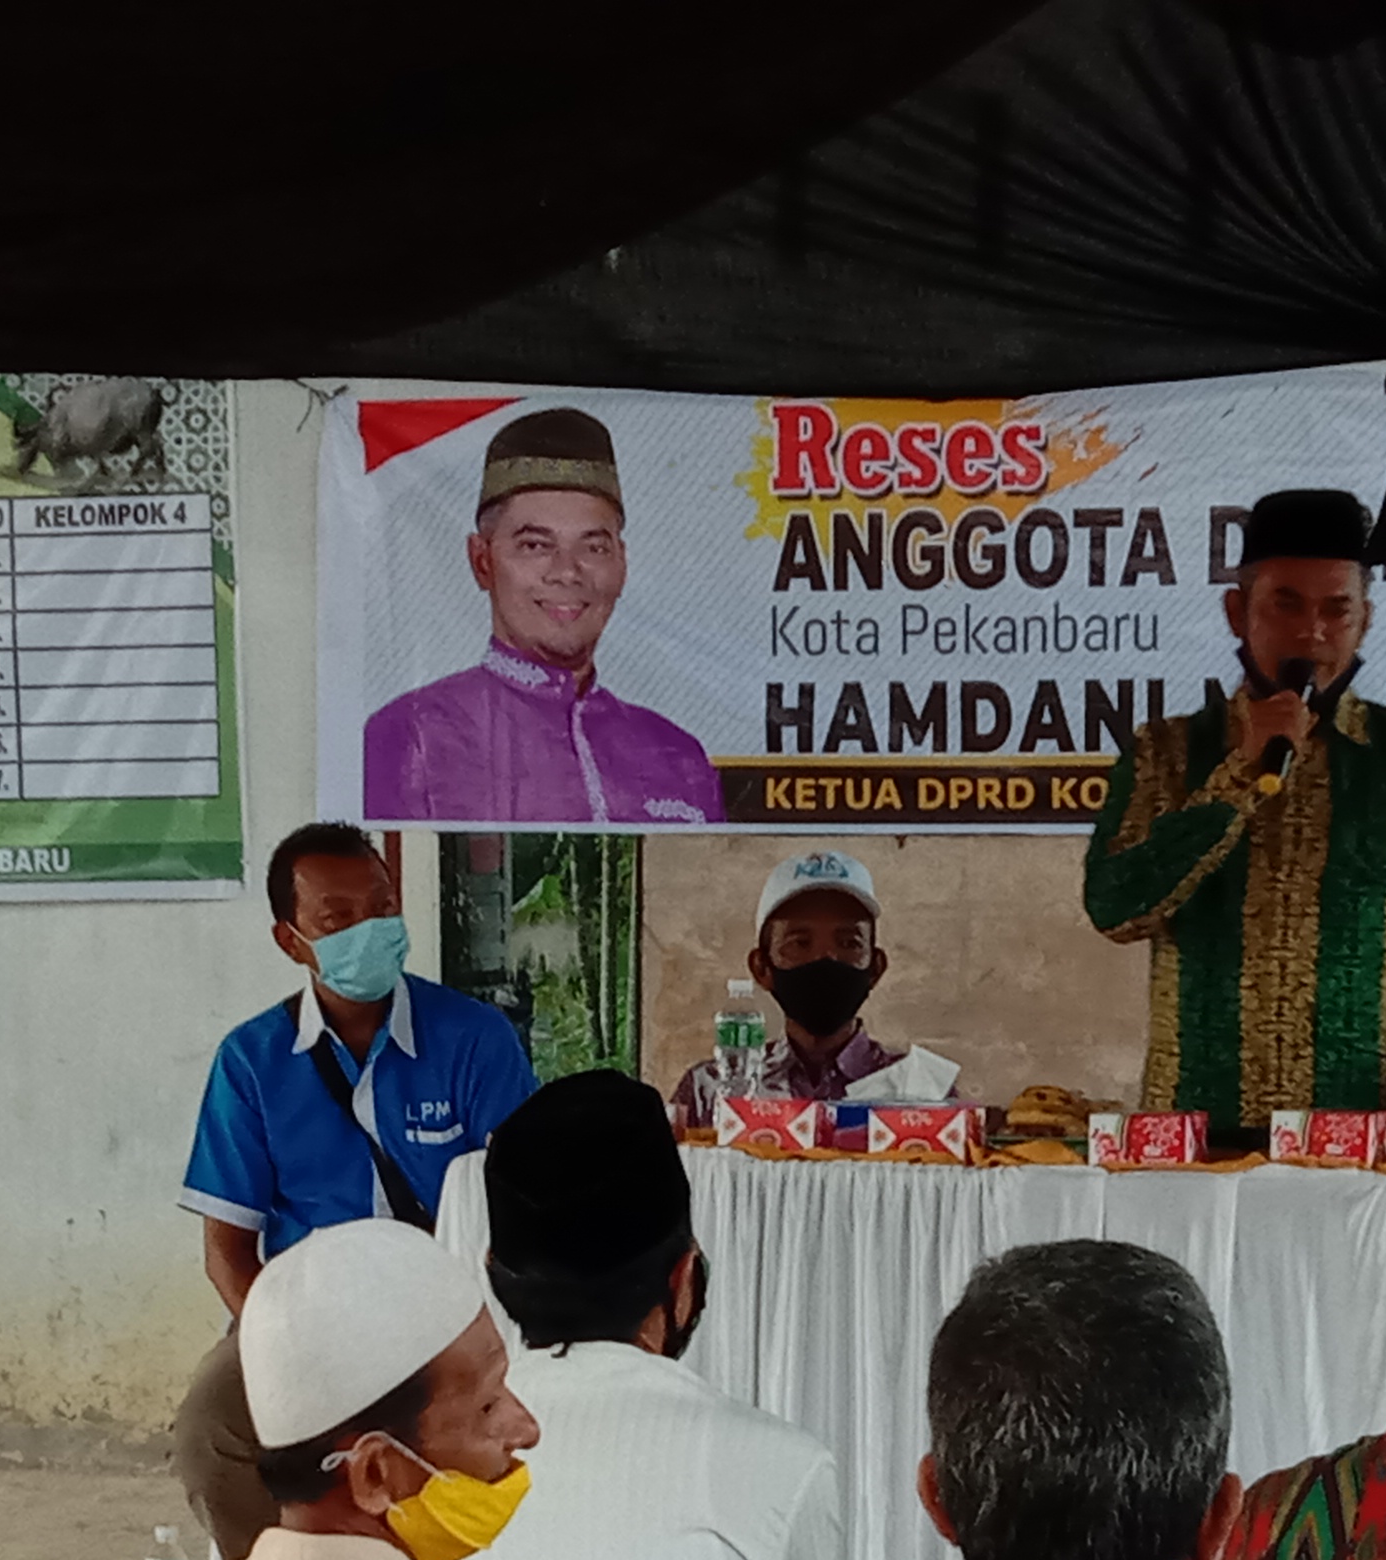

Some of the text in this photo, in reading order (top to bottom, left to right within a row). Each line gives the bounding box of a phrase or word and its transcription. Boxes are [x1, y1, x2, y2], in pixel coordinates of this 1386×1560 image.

[771, 403, 1046, 494] Reses
[35, 502, 187, 528] KELOMPOK 4
[773, 507, 1177, 592] ANGGOTA
[771, 600, 1159, 657] Kota Pekanbaru
[765, 776, 903, 810] KETUA
[917, 776, 1036, 810] DPRD
[406, 1100, 451, 1123] LPM
